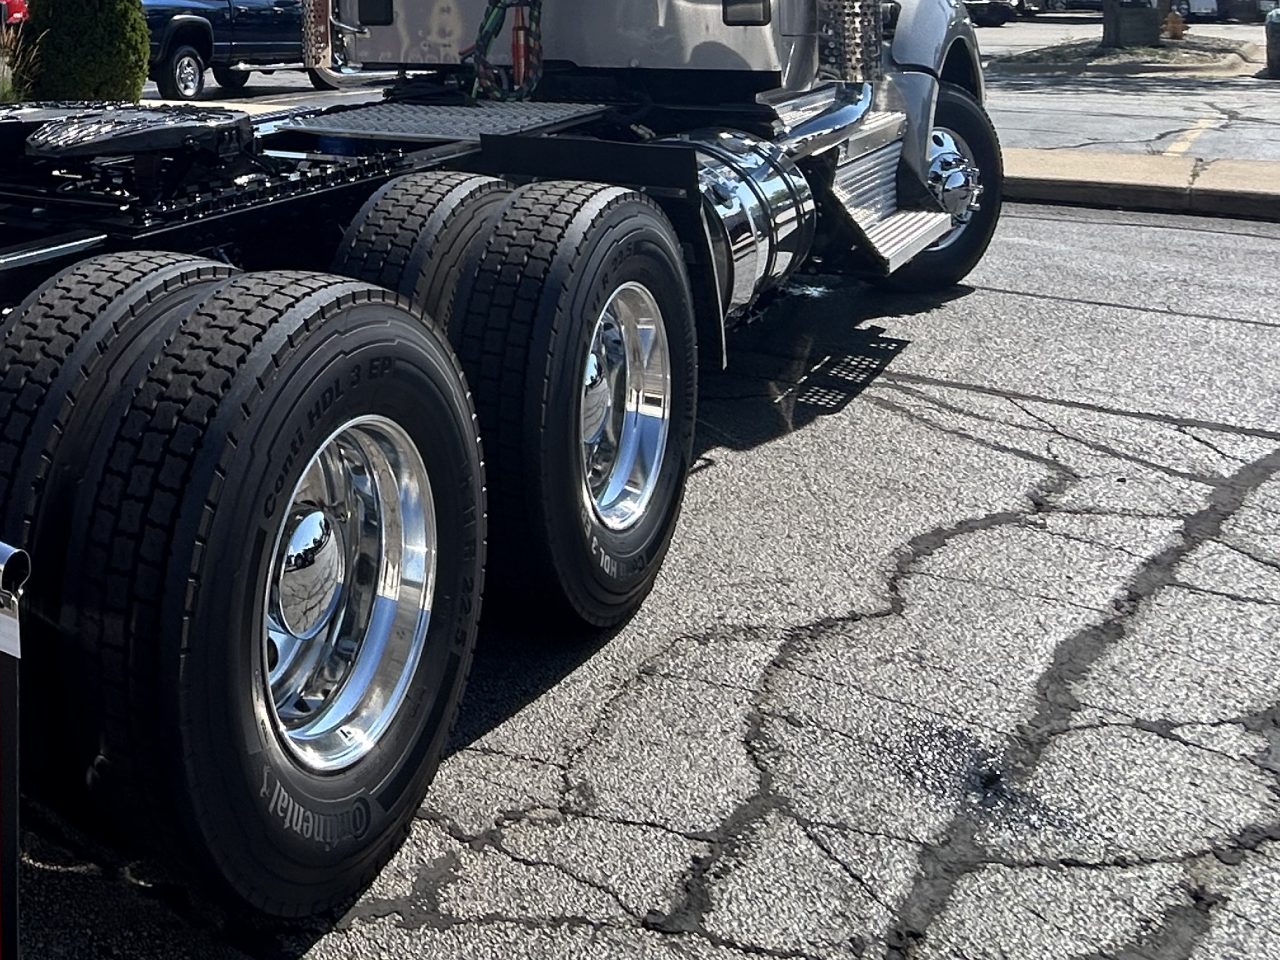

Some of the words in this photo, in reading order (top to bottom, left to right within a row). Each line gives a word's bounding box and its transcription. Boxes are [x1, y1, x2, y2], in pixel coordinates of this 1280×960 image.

[263, 426, 306, 520] Conti
[306, 378, 345, 430] HDL
[350, 364, 362, 390] 3
[367, 355, 393, 380] EP
